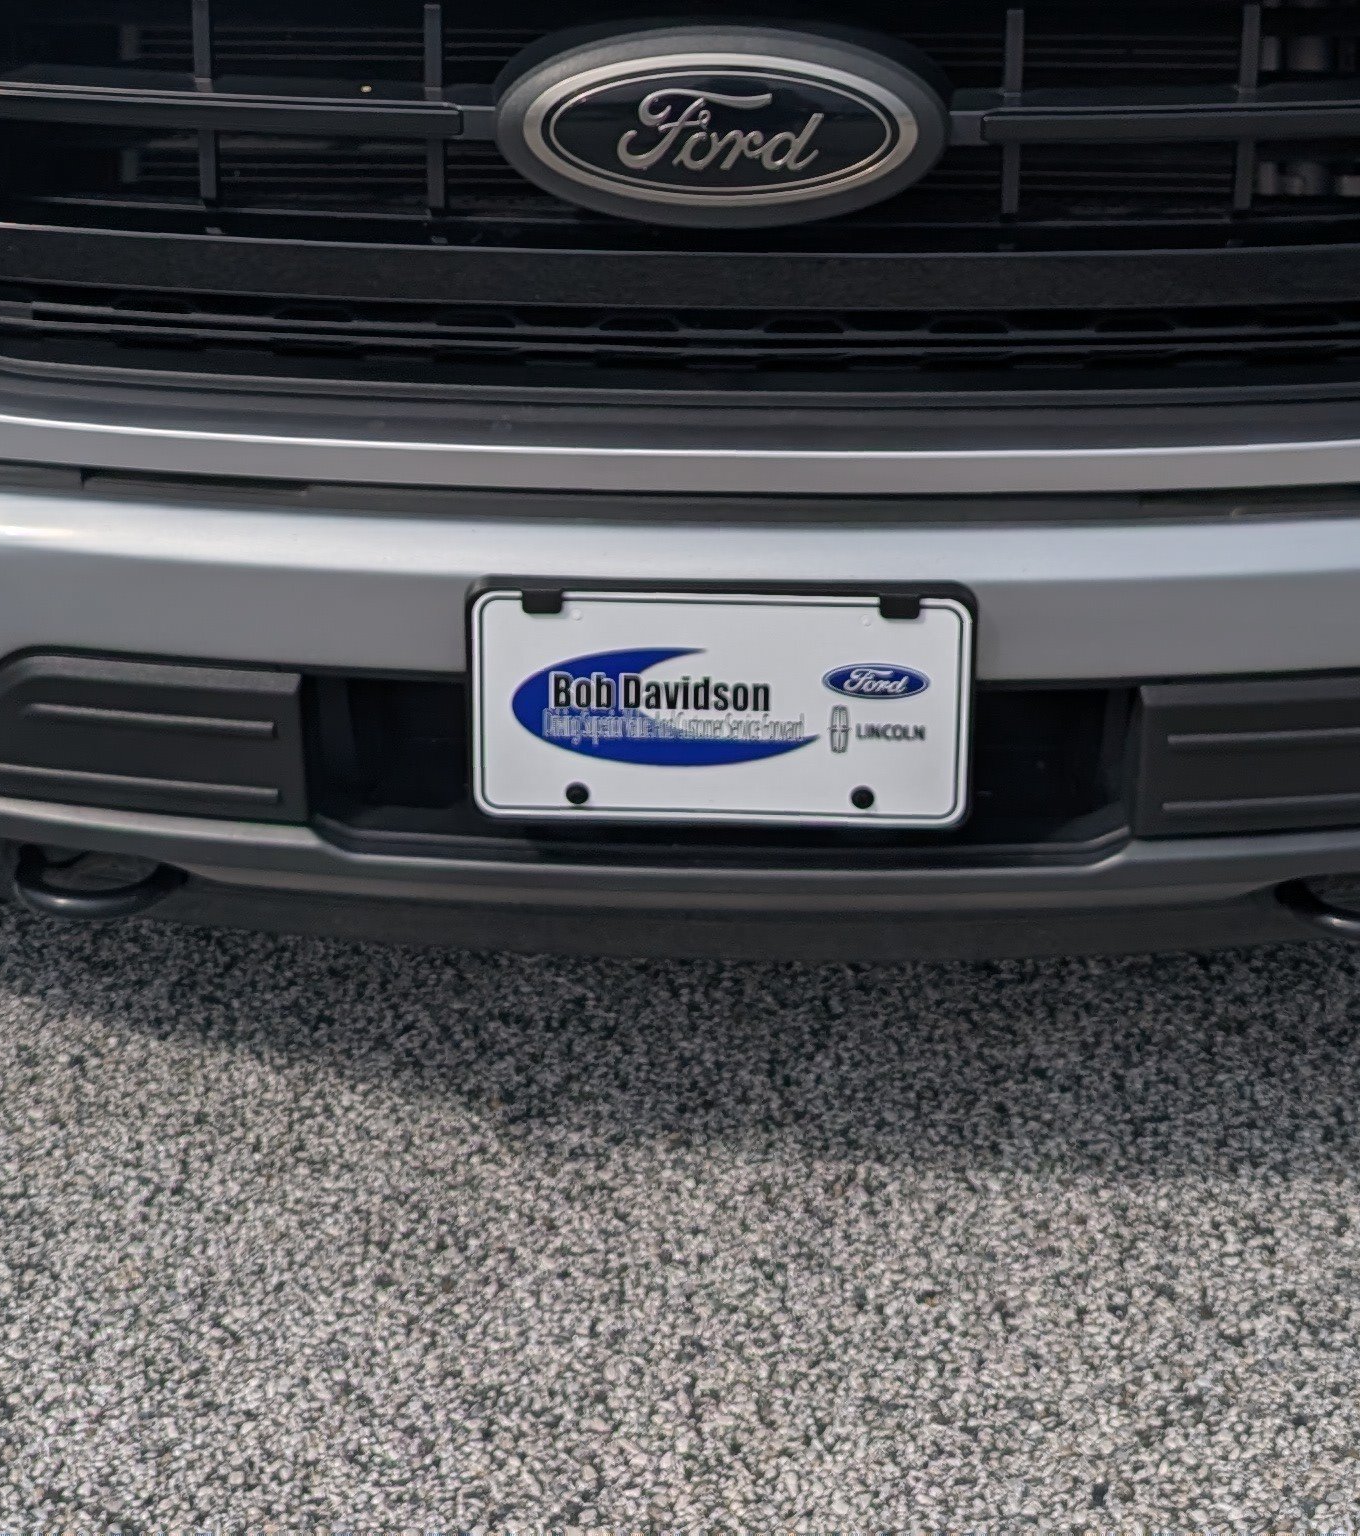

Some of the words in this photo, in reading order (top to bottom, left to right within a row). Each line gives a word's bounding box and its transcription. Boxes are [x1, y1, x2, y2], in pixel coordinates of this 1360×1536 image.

[617, 87, 825, 172] Ford
[549, 670, 616, 710] Bob
[619, 672, 771, 712] Davidson
[843, 667, 910, 694] Ford
[855, 723, 926, 742] LINCOLN
